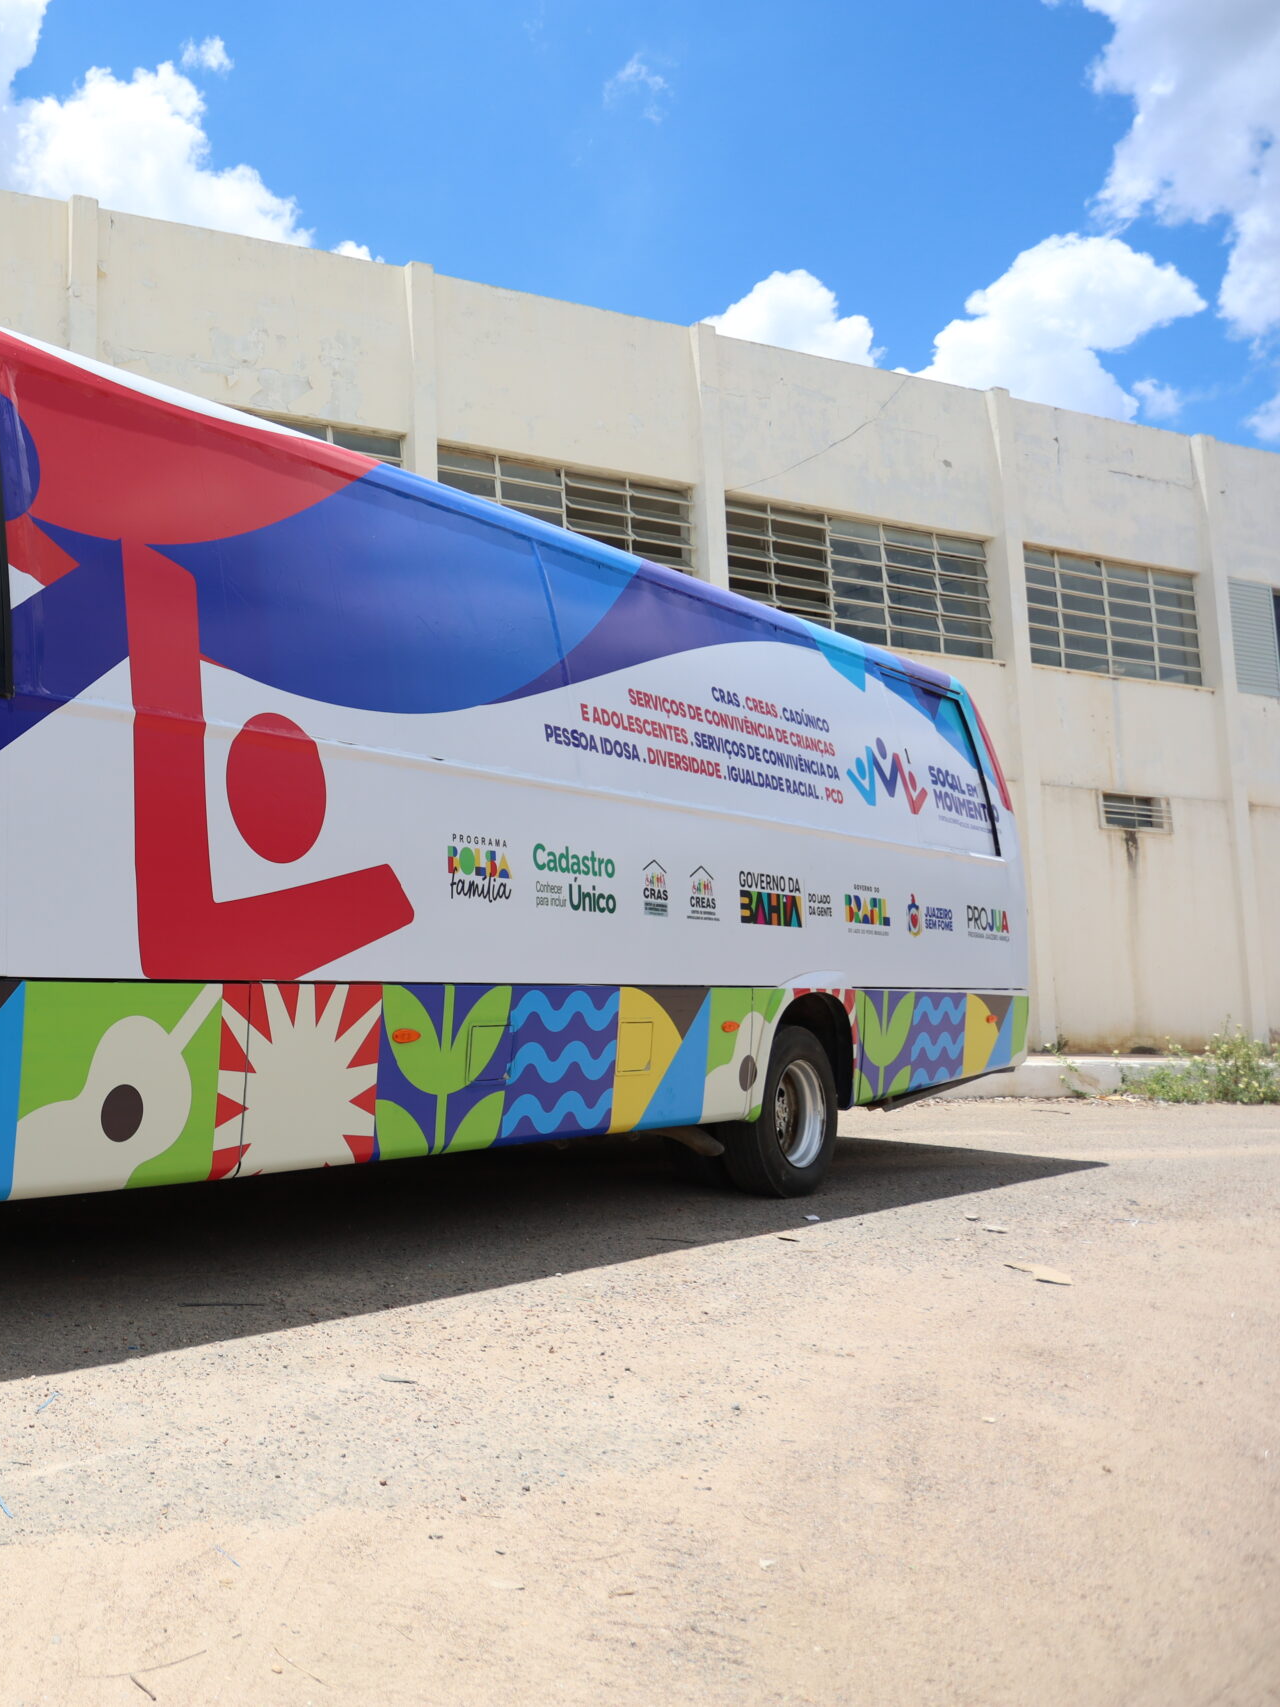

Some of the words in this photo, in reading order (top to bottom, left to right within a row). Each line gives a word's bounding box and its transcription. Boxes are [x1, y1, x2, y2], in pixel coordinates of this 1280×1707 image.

[711, 686, 740, 708] CRAS
[745, 696, 778, 719] CREAS
[782, 707, 830, 733] CADÚNICO
[628, 688, 687, 718] SERVIÇOS
[687, 704, 704, 723] DE
[704, 708, 775, 741] CONVIVÊNCIA
[775, 727, 790, 745] DE
[789, 731, 836, 758] CRIANÇAS
[580, 703, 590, 722] E
[593, 706, 688, 745] ADOLESCENTES
[694, 731, 746, 759] SERVIÇOS
[747, 744, 762, 762] DE
[762, 748, 826, 777] CONVIVÊNCIA
[826, 764, 840, 780] DA
[544, 723, 598, 753] PESSOA
[600, 736, 640, 762] IDOSA
[647, 747, 722, 779] DIVERSIDADE
[727, 765, 785, 792] IGUALDADE
[786, 778, 819, 800] RACIAL
[824, 787, 843, 804] PCD
[966, 783, 979, 798] EM
[452, 833, 508, 848] PROGRAMA
[447, 845, 512, 879] BOLSA
[533, 843, 616, 878] Cadastro
[450, 867, 512, 903] família
[535, 880, 563, 894] Conhecer
[643, 887, 668, 901] CRAS
[739, 870, 786, 892] GOVERNO
[788, 877, 801, 893] DA
[535, 896, 549, 908] para
[550, 895, 567, 908] incluir
[569, 877, 617, 914] Único
[689, 895, 717, 909] CREAS
[808, 893, 816, 904] DO
[817, 894, 831, 905] LADO
[739, 890, 803, 928] BAHIA
[808, 906, 816, 916] DA
[816, 907, 832, 917] GENTE
[844, 893, 891, 926] BRASIL
[924, 906, 953, 921] JUAZEIRO
[966, 904, 1009, 934] PROJUA
[925, 918, 937, 930] SEM
[938, 920, 953, 932] FOME
